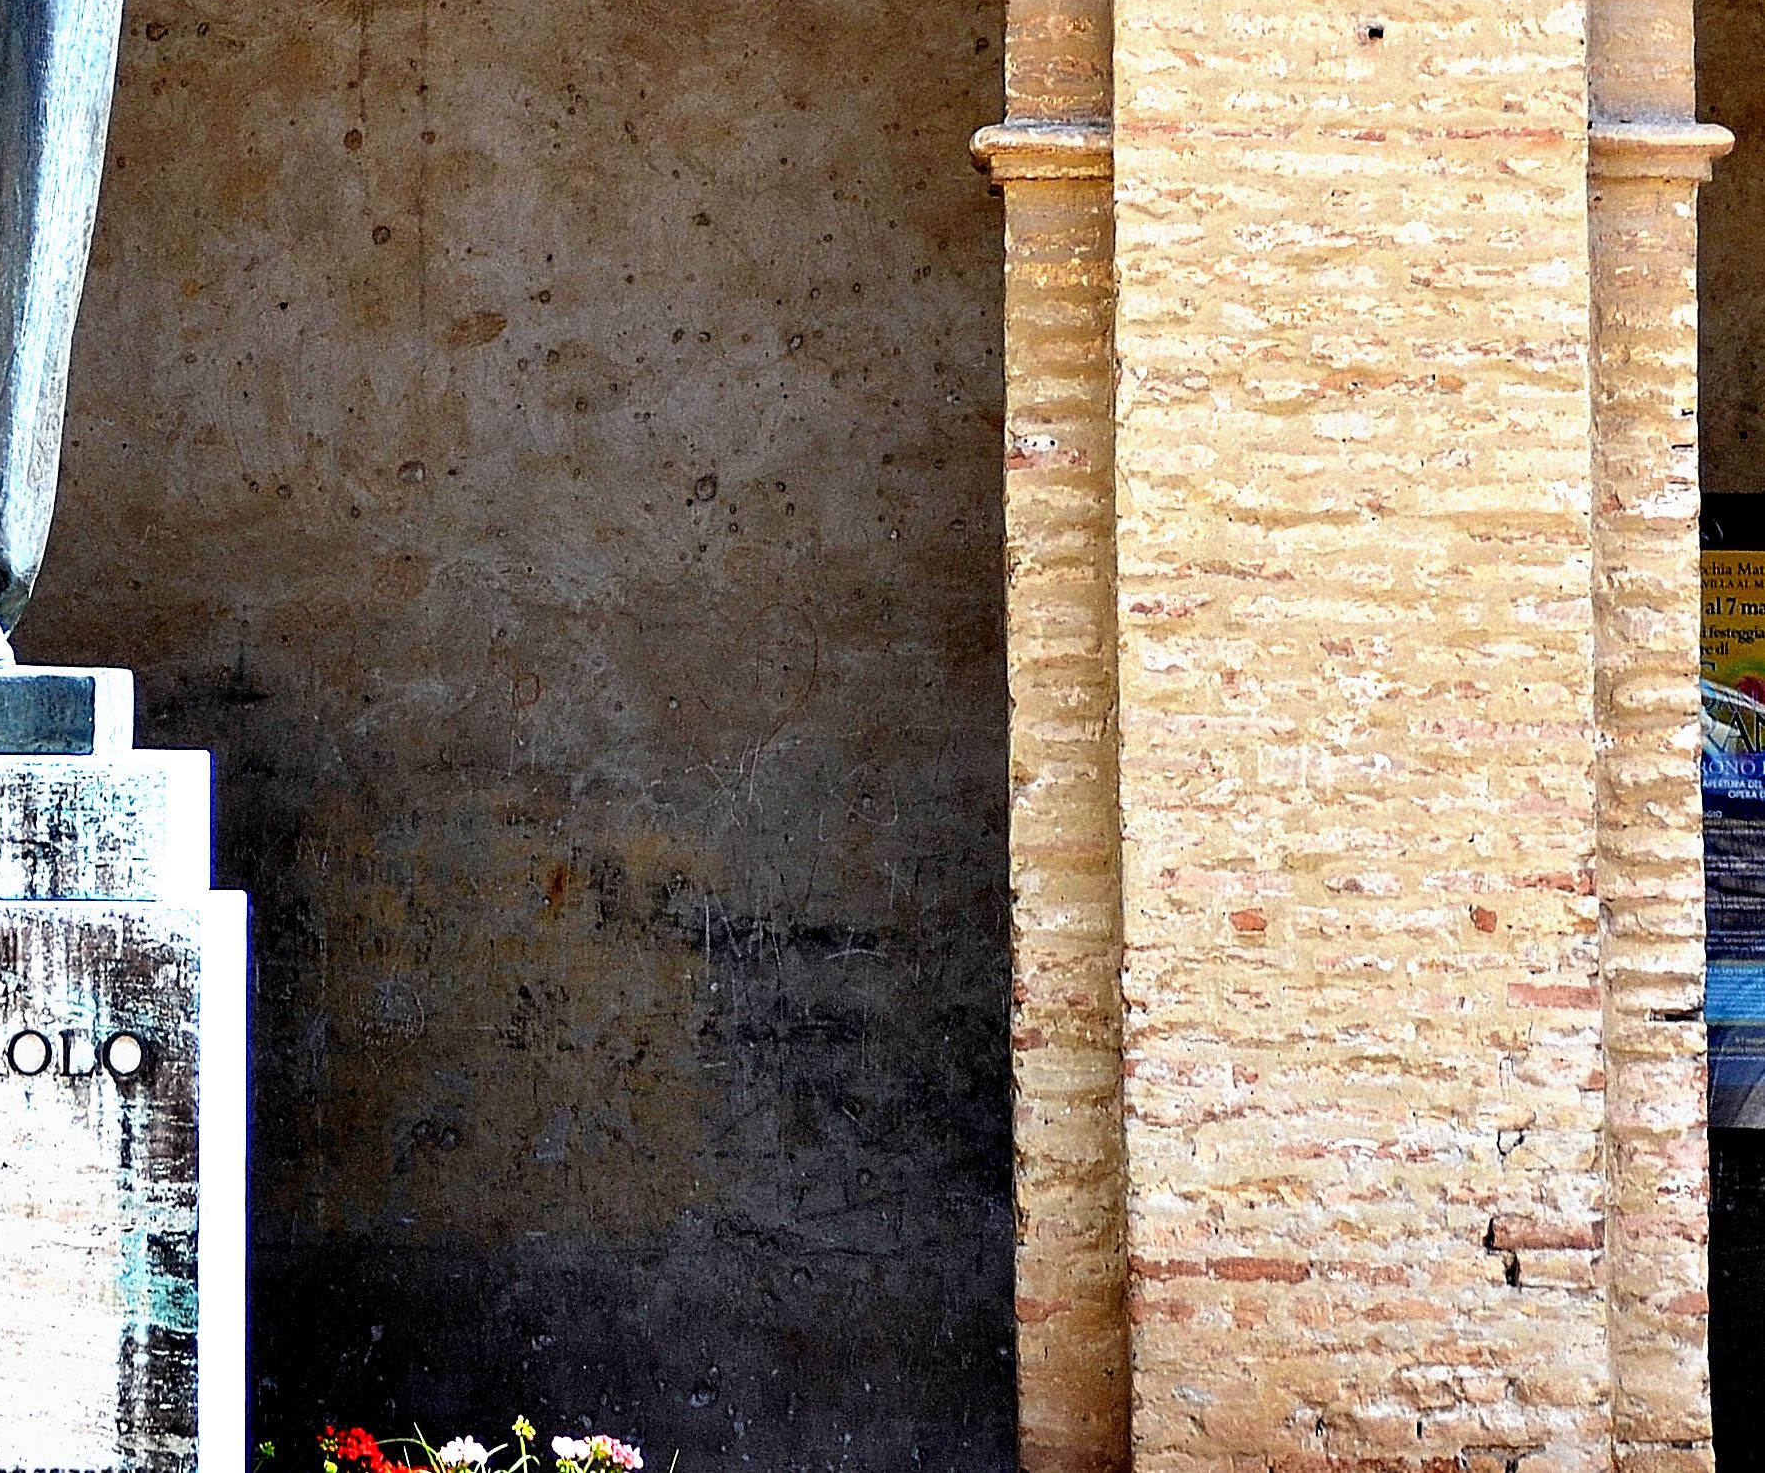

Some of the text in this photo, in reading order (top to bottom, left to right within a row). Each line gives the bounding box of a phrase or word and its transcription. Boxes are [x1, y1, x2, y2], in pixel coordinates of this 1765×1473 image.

[1705, 596, 1722, 615] al
[1725, 597, 1737, 616] 7
[1715, 641, 1729, 655] di
